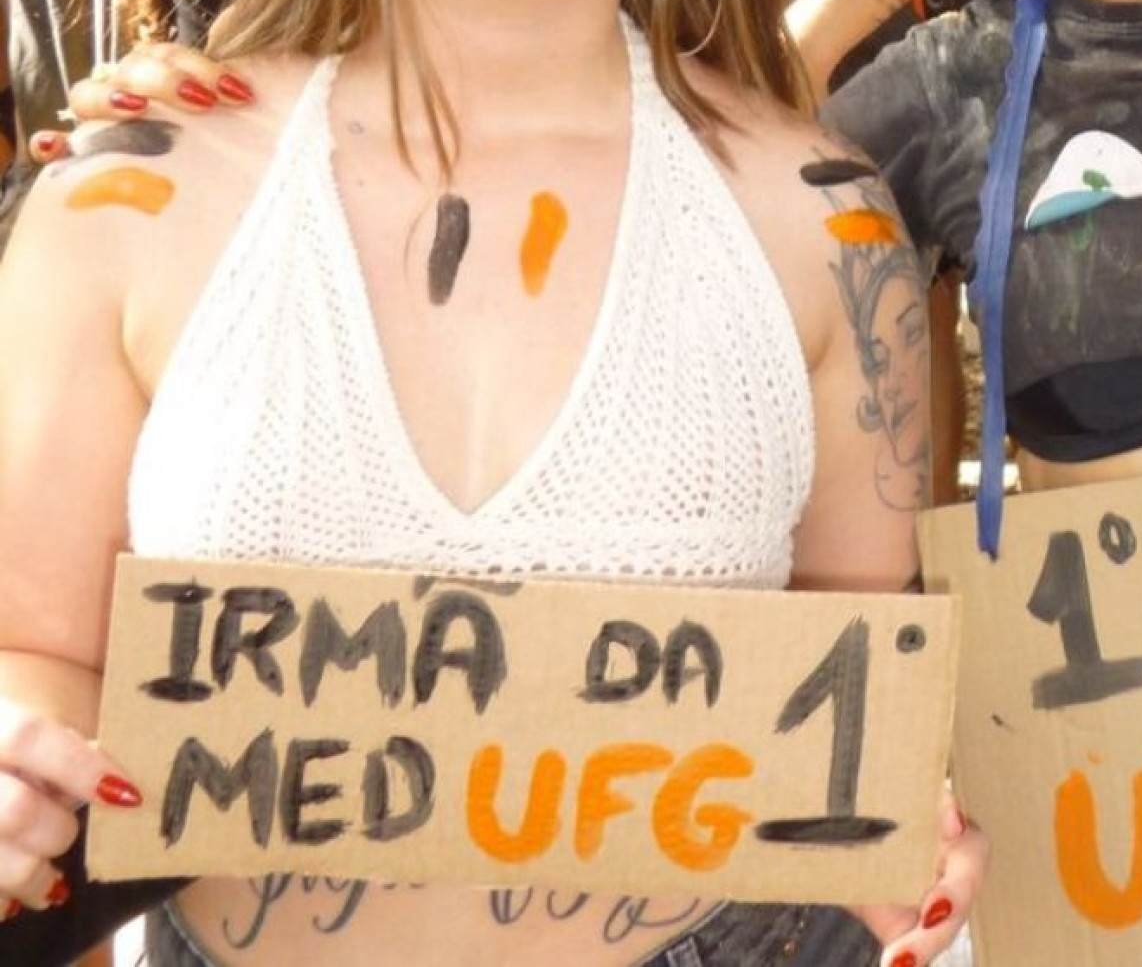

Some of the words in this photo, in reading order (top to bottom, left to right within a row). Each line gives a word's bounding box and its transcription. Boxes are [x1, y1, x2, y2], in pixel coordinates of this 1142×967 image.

[138, 576, 523, 714] IRMÃ
[572, 619, 724, 708] DA
[158, 727, 437, 848] MED
[465, 742, 756, 872] UFG
